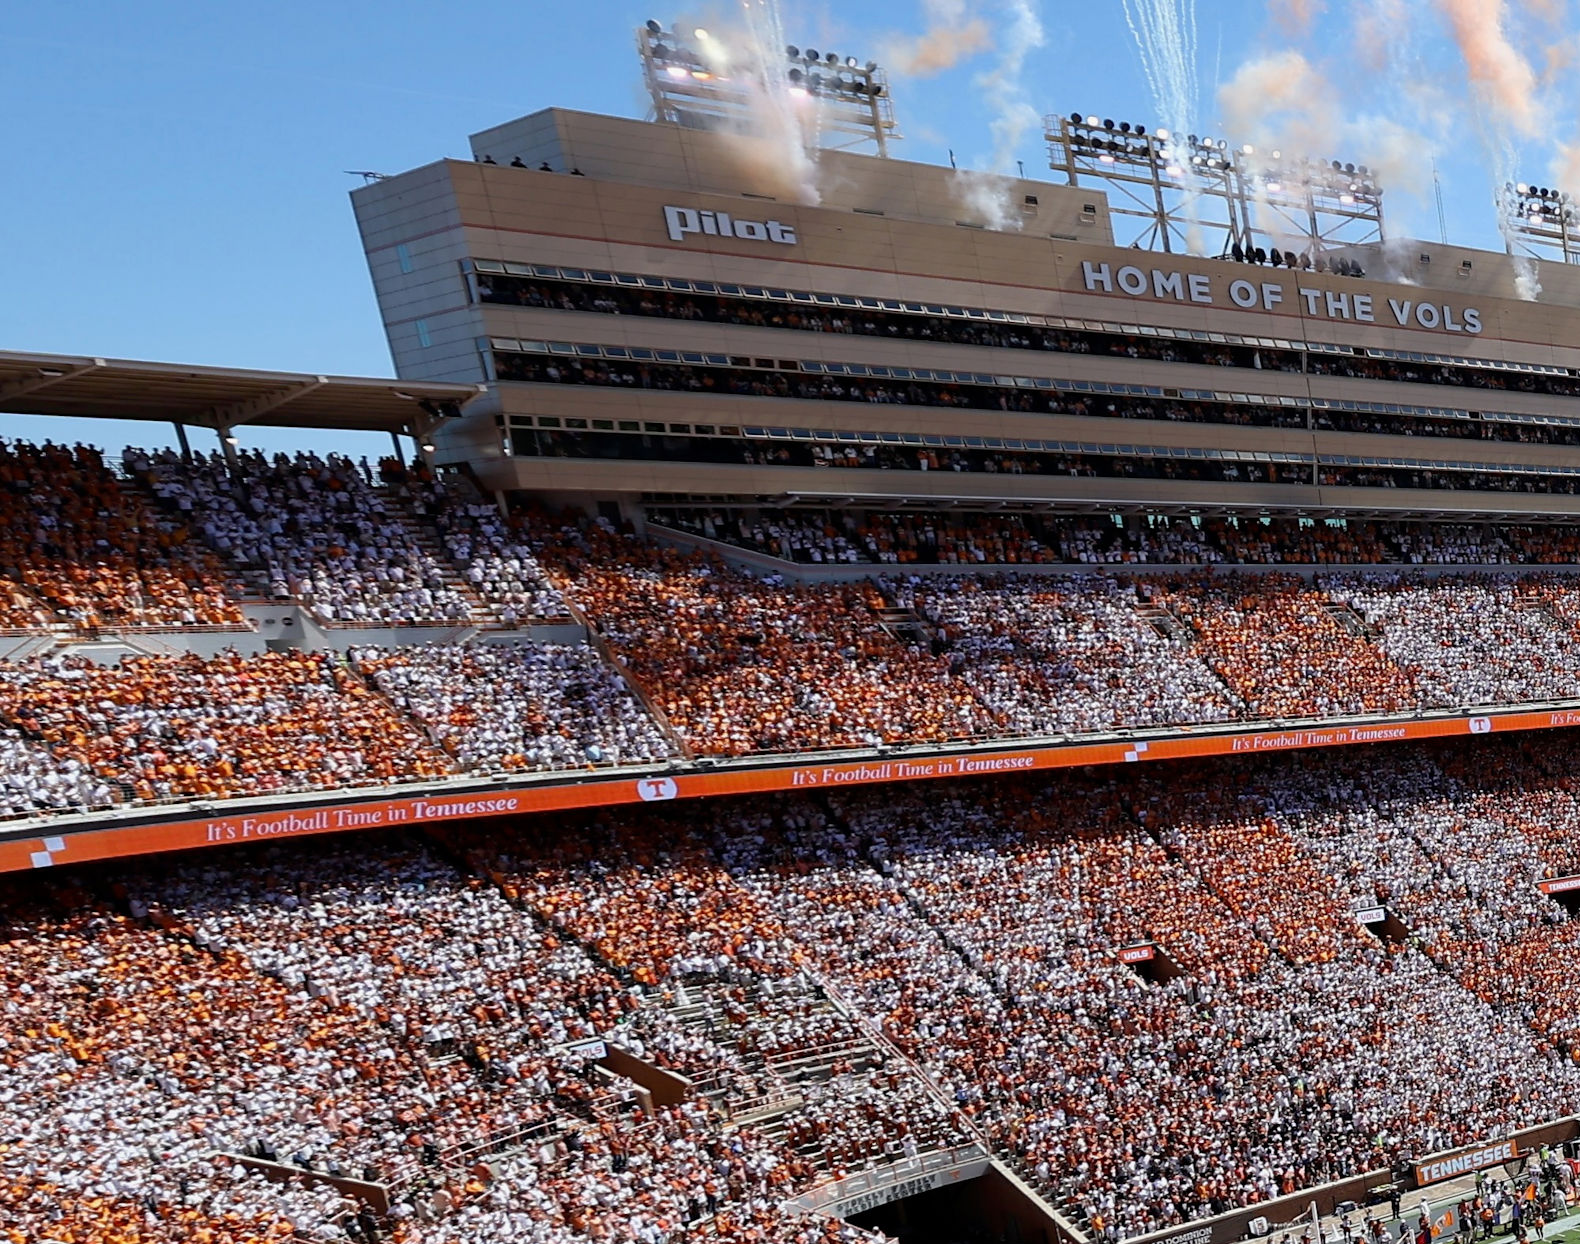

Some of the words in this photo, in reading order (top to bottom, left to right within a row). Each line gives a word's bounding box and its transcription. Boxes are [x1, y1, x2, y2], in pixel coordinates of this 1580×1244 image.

[1082, 261, 1213, 304] HOME
[1230, 279, 1283, 310] OF
[1300, 287, 1375, 322] THE
[1389, 298, 1483, 334] VOLS
[1475, 719, 1485, 730] T
[1254, 734, 1302, 748] Football
[1304, 732, 1332, 744] Time
[1336, 730, 1346, 742] in
[1349, 728, 1405, 740] Tennessee
[822, 764, 891, 783] Football
[895, 762, 933, 776] Time
[938, 759, 952, 774] in
[956, 756, 1034, 772] Tennessee
[647, 780, 666, 796] T
[242, 812, 328, 839] Football
[334, 808, 382, 830] Time
[388, 806, 406, 823] in
[412, 798, 518, 821] Tennessee
[1124, 950, 1148, 960] VOLS
[1420, 1140, 1513, 1184] TENNESSEE
